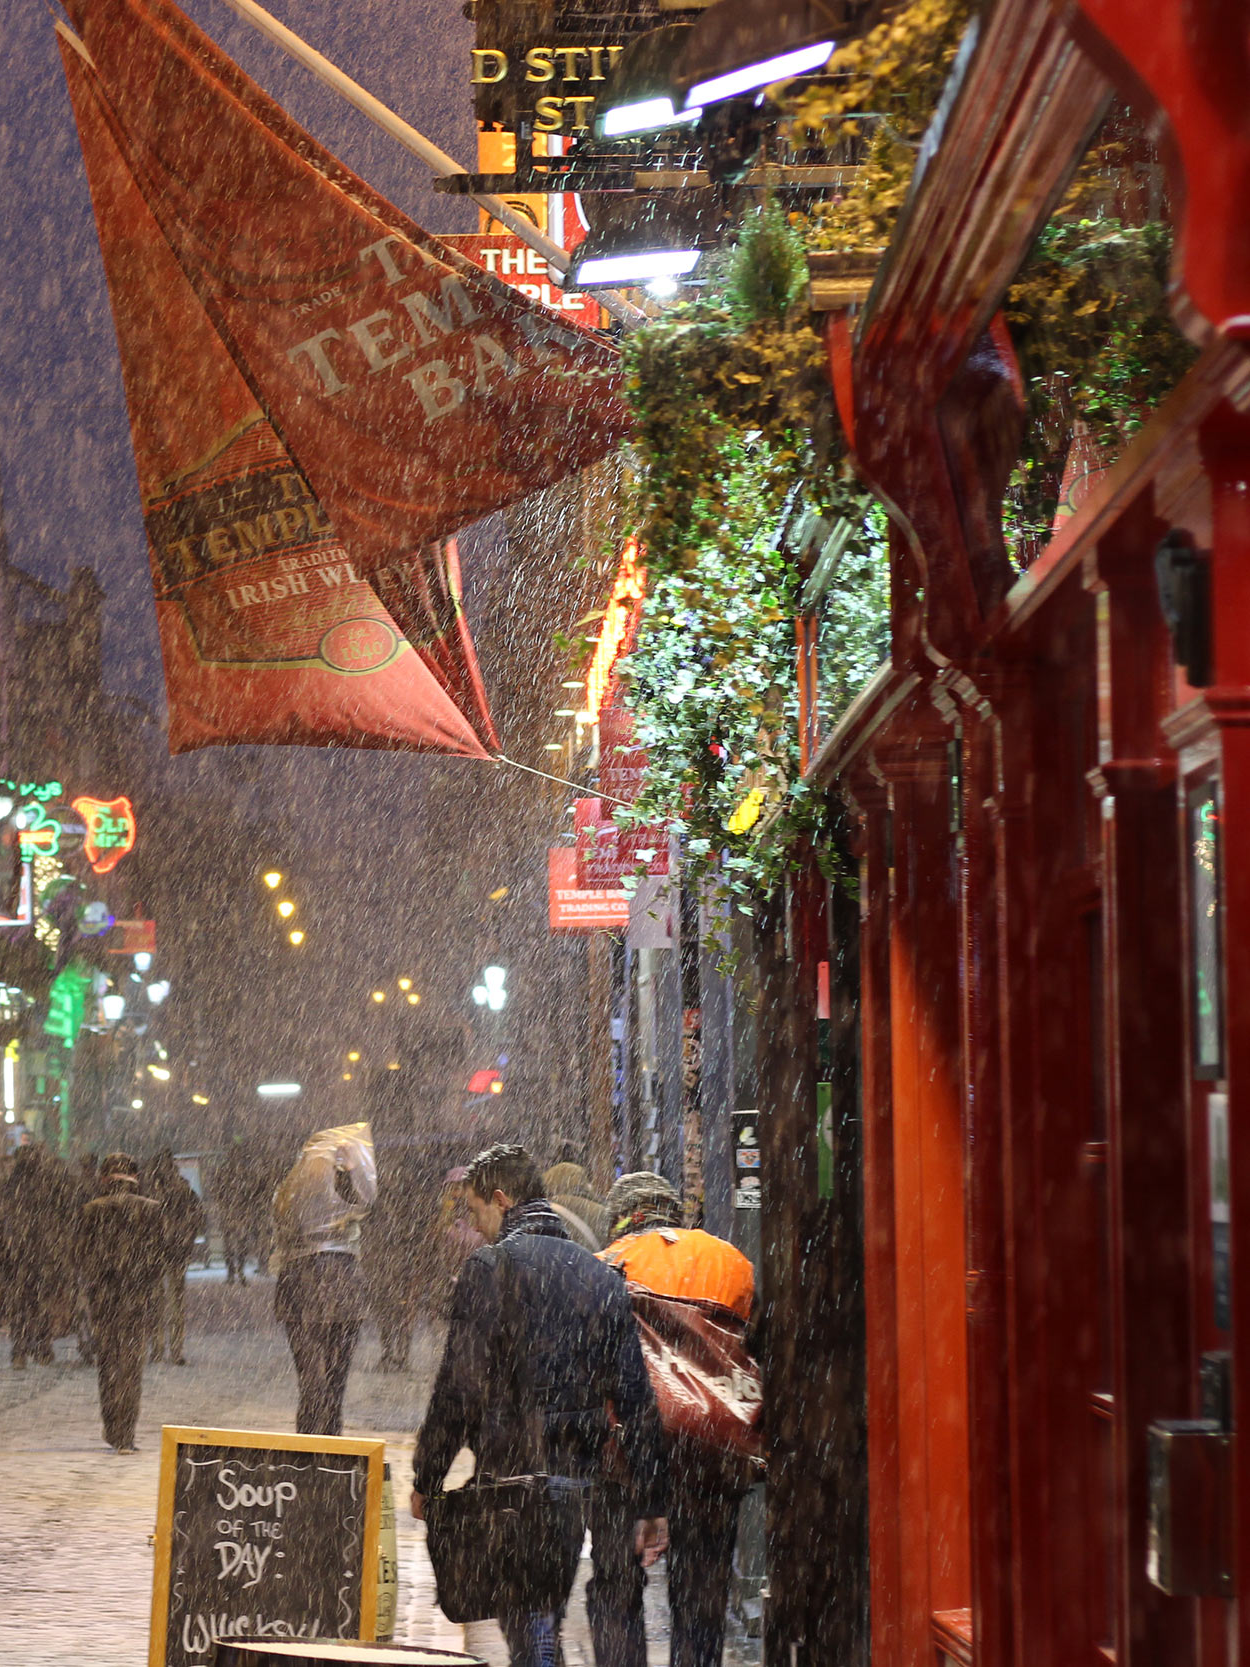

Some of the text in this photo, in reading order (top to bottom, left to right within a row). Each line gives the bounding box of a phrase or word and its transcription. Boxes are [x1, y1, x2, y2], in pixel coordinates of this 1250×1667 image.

[480, 248, 548, 275] THE
[291, 284, 343, 319] TRADE
[510, 284, 585, 310] PLE
[287, 273, 500, 398] TEM
[225, 571, 311, 610] IRISH
[555, 889, 604, 901] TEMPLE
[559, 902, 610, 913] TRADING
[251, 1521, 284, 1540] THE
